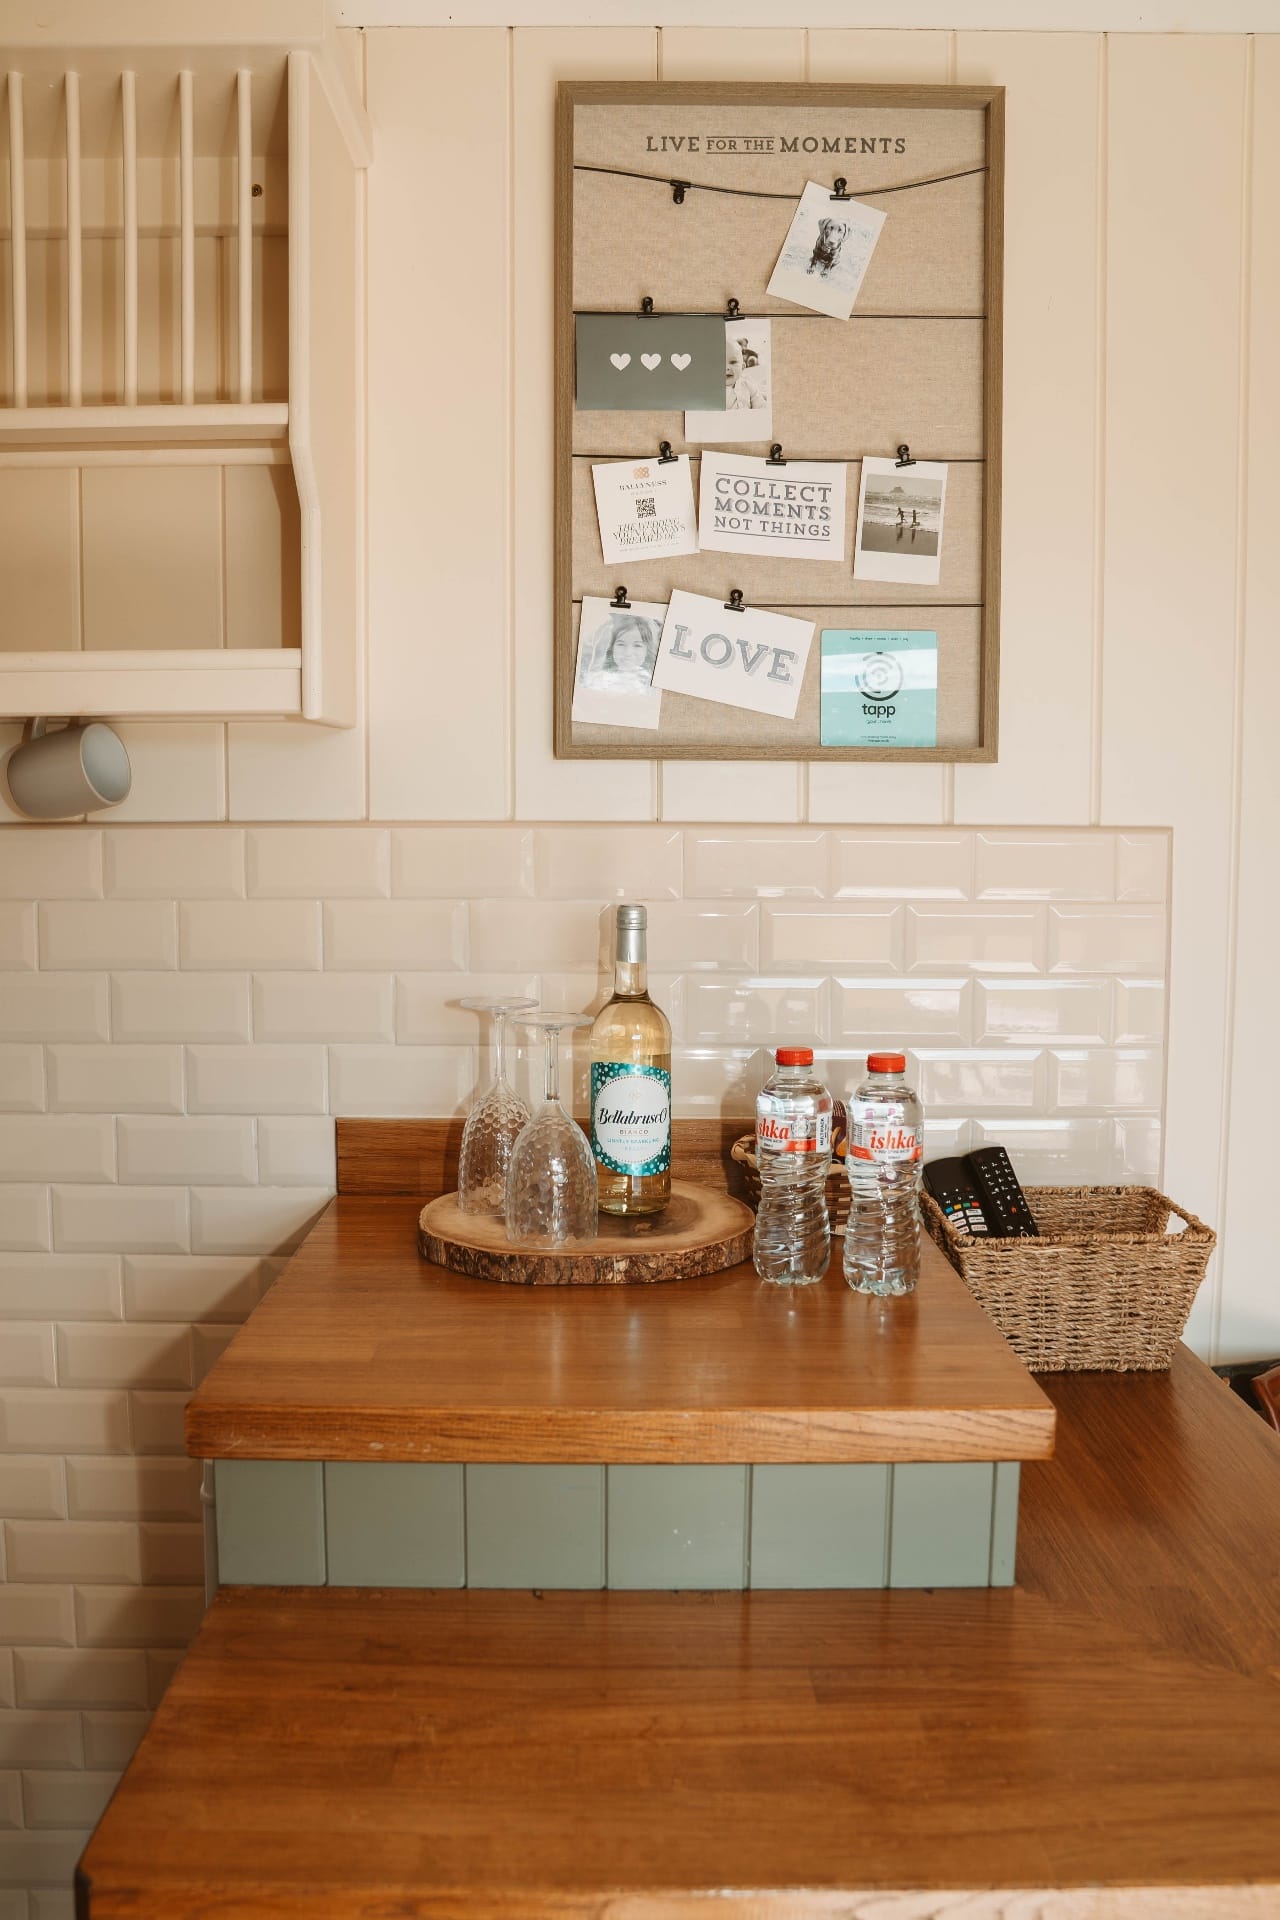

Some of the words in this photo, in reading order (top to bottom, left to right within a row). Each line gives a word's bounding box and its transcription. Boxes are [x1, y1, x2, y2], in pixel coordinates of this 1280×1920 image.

[646, 136, 700, 152] LIVE
[706, 139, 737, 150] FOR
[743, 139, 775, 151] THE
[779, 136, 907, 154] MOMENTS
[715, 477, 832, 503] COLLECT
[714, 496, 832, 520] MOMENTS
[714, 515, 753, 531] NOT
[760, 520, 831, 537] THINGS
[669, 624, 798, 684] LOVE
[861, 703, 896, 718] tapp
[757, 1118, 789, 1140] shka
[870, 1128, 915, 1149] ishka
